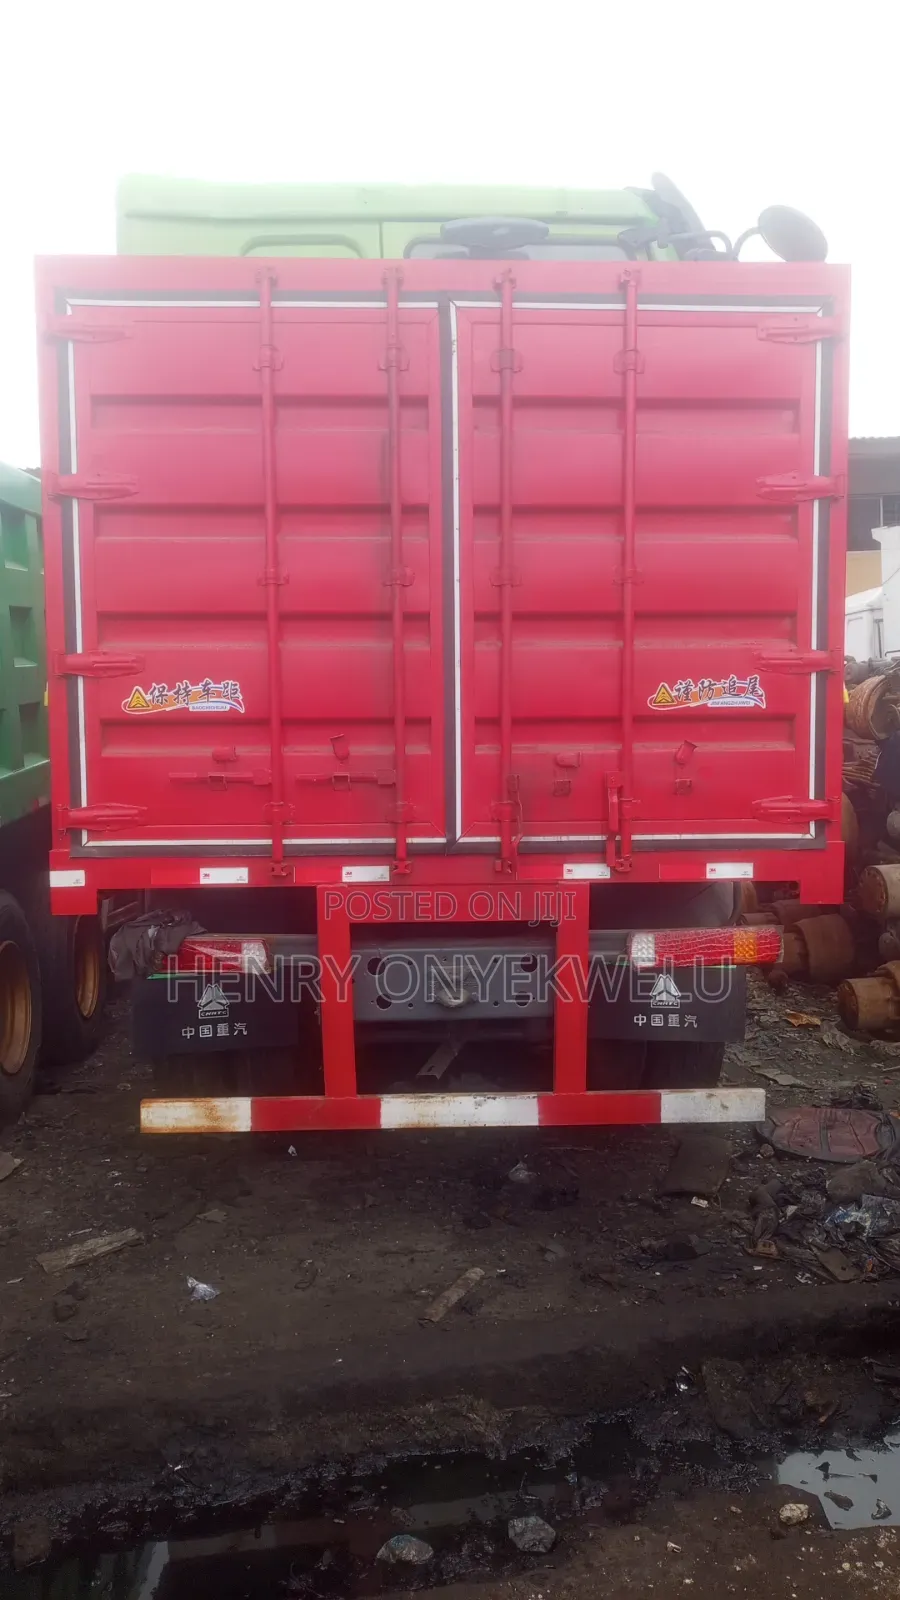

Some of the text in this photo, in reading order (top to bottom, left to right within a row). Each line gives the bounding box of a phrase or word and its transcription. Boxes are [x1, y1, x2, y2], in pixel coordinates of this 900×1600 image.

[149, 679, 240, 706] 保持车距
[674, 675, 763, 702] 谨防追尾
[181, 1022, 248, 1040] 中国重汽
[633, 1013, 698, 1029] 中国重汽
